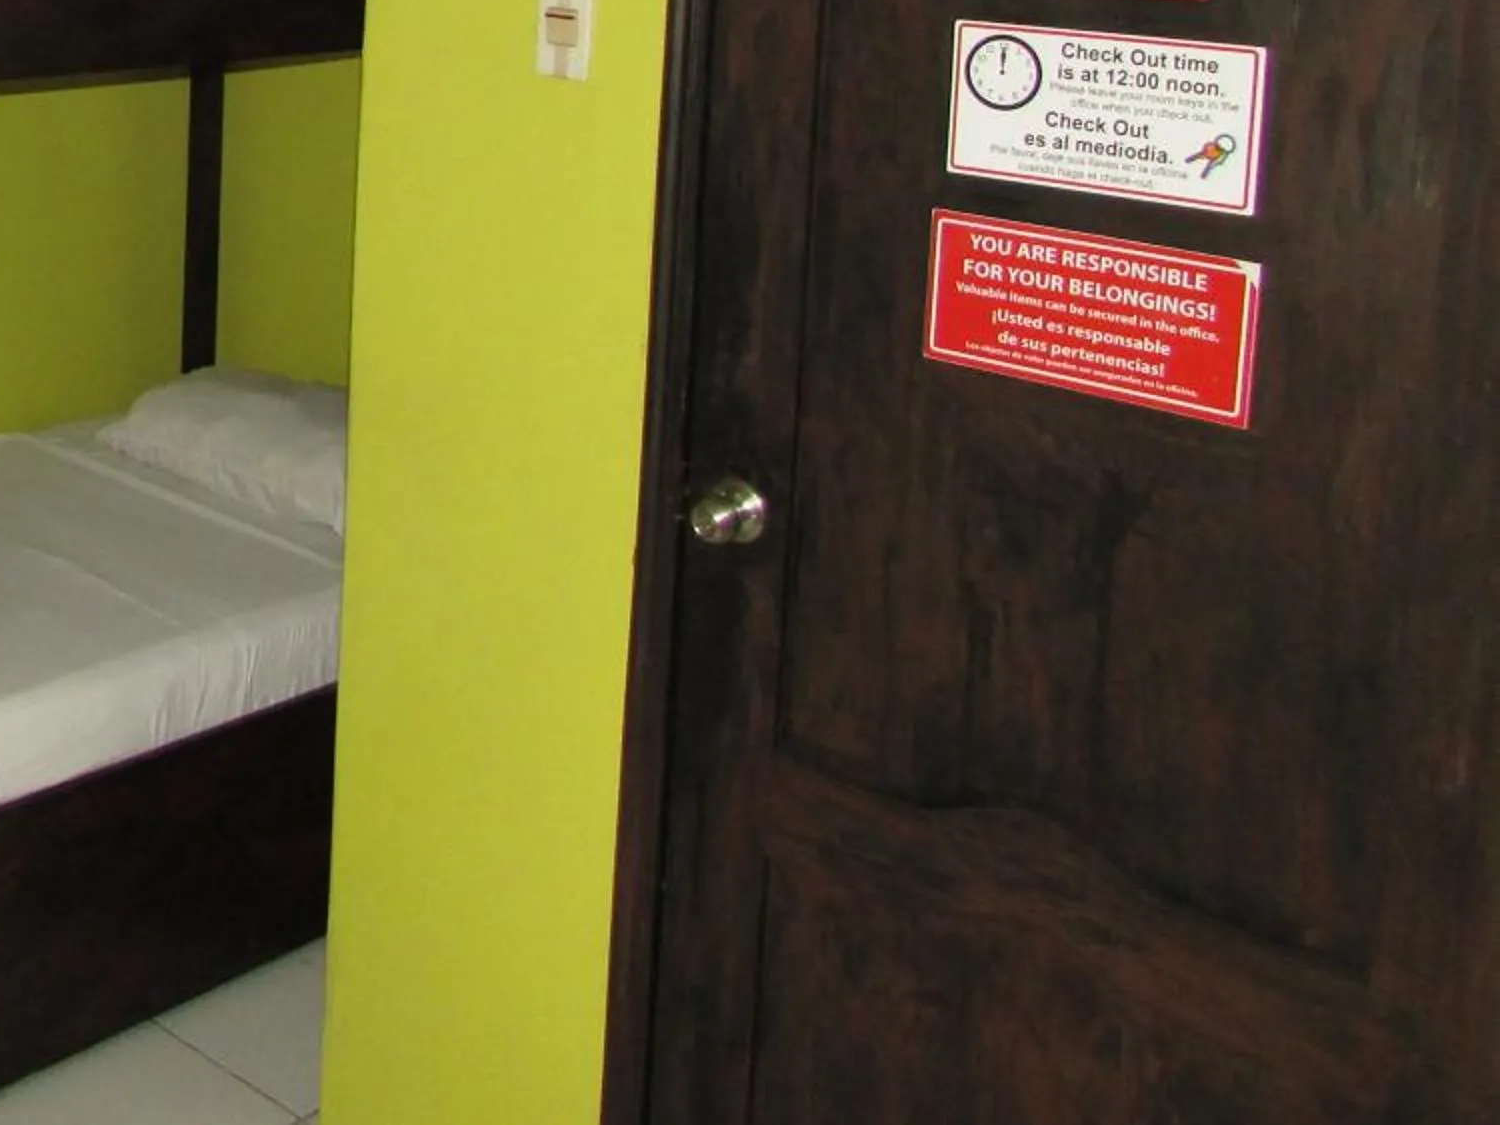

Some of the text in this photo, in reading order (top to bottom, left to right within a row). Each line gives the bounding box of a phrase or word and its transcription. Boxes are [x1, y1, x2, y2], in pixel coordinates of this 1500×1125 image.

[1061, 42, 1219, 74] Check Out time
[1057, 63, 1226, 97] is at 12:00 noon.
[1045, 110, 1149, 140] Check Out
[1220, 99, 1240, 113] the
[1024, 132, 1046, 148] es
[1052, 134, 1069, 151] al
[970, 233, 1208, 292] YOU ARE RESPONSIBLE
[963, 258, 1216, 322] FOR YOUR BELONGINGS!
[955, 280, 1220, 343] Valuable items can be secured in the office.
[991, 308, 1171, 356] ¡Usted es responsable
[997, 330, 1165, 378] de sus pertenencias!
